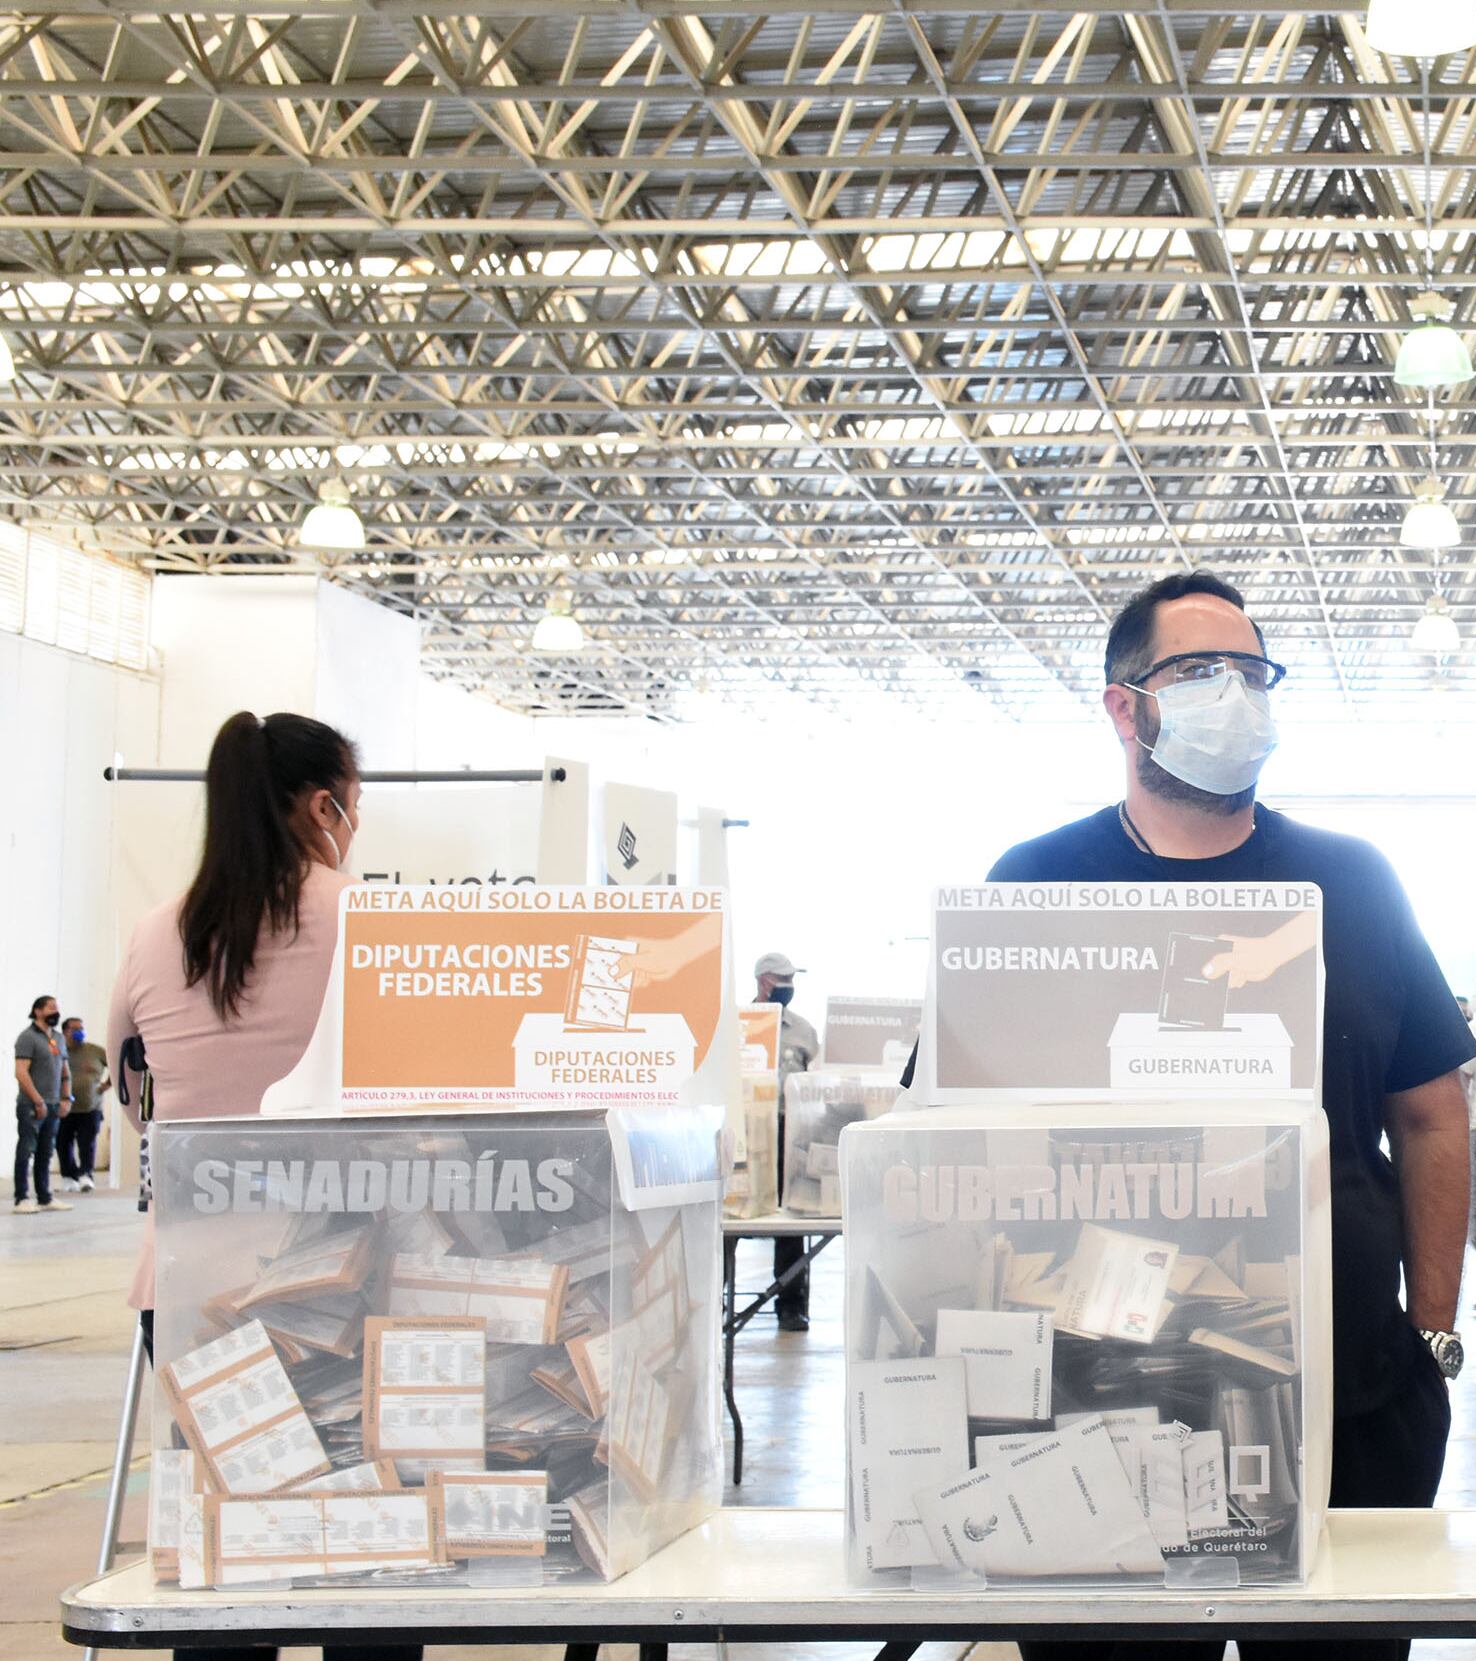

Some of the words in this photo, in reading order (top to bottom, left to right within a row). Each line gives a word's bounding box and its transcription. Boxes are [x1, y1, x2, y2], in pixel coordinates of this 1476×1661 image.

[348, 891, 414, 909] META
[420, 887, 481, 911] AQUÍ
[488, 891, 553, 910] SOLO
[559, 891, 588, 909] LA
[594, 891, 687, 909] BOLETA
[693, 891, 722, 909] DE
[937, 888, 1005, 908] META
[1011, 883, 1072, 909] AQUÍ
[1078, 888, 1143, 908] SOLO
[1150, 888, 1179, 907] LA
[1186, 888, 1278, 908] BOLETA
[1285, 888, 1316, 907] DE
[352, 944, 570, 970] DIPUTACIONES
[941, 945, 1159, 972] GUBERNATURA
[379, 972, 543, 997] FEDERALES
[534, 1050, 676, 1067] DIPUTACIONES
[1128, 1058, 1274, 1075] GUBERNATURA
[551, 1068, 657, 1084] FEDERALES
[419, 1091, 434, 1100] LEY
[438, 1091, 480, 1100] GENERAL
[482, 1091, 494, 1100] DE
[496, 1091, 565, 1100] INSTITUCIONES
[567, 1091, 573, 1100] Y
[575, 1091, 655, 1100] PROCEDIMIENTOS
[192, 1149, 575, 1214] SENADURÍAS
[883, 1162, 1268, 1222] GUBERNATURA
[884, 1374, 937, 1384] GUBERNATURA
[1010, 1441, 1062, 1468] GUBERNATURA
[940, 1472, 991, 1500] GUBERNATURA
[1071, 1465, 1098, 1517] GUBERNATURA
[1008, 1494, 1034, 1545] GUBERNATURA
[1247, 1526, 1267, 1537] del
[1183, 1542, 1199, 1552] de
[1203, 1541, 1268, 1553] Querétaro
